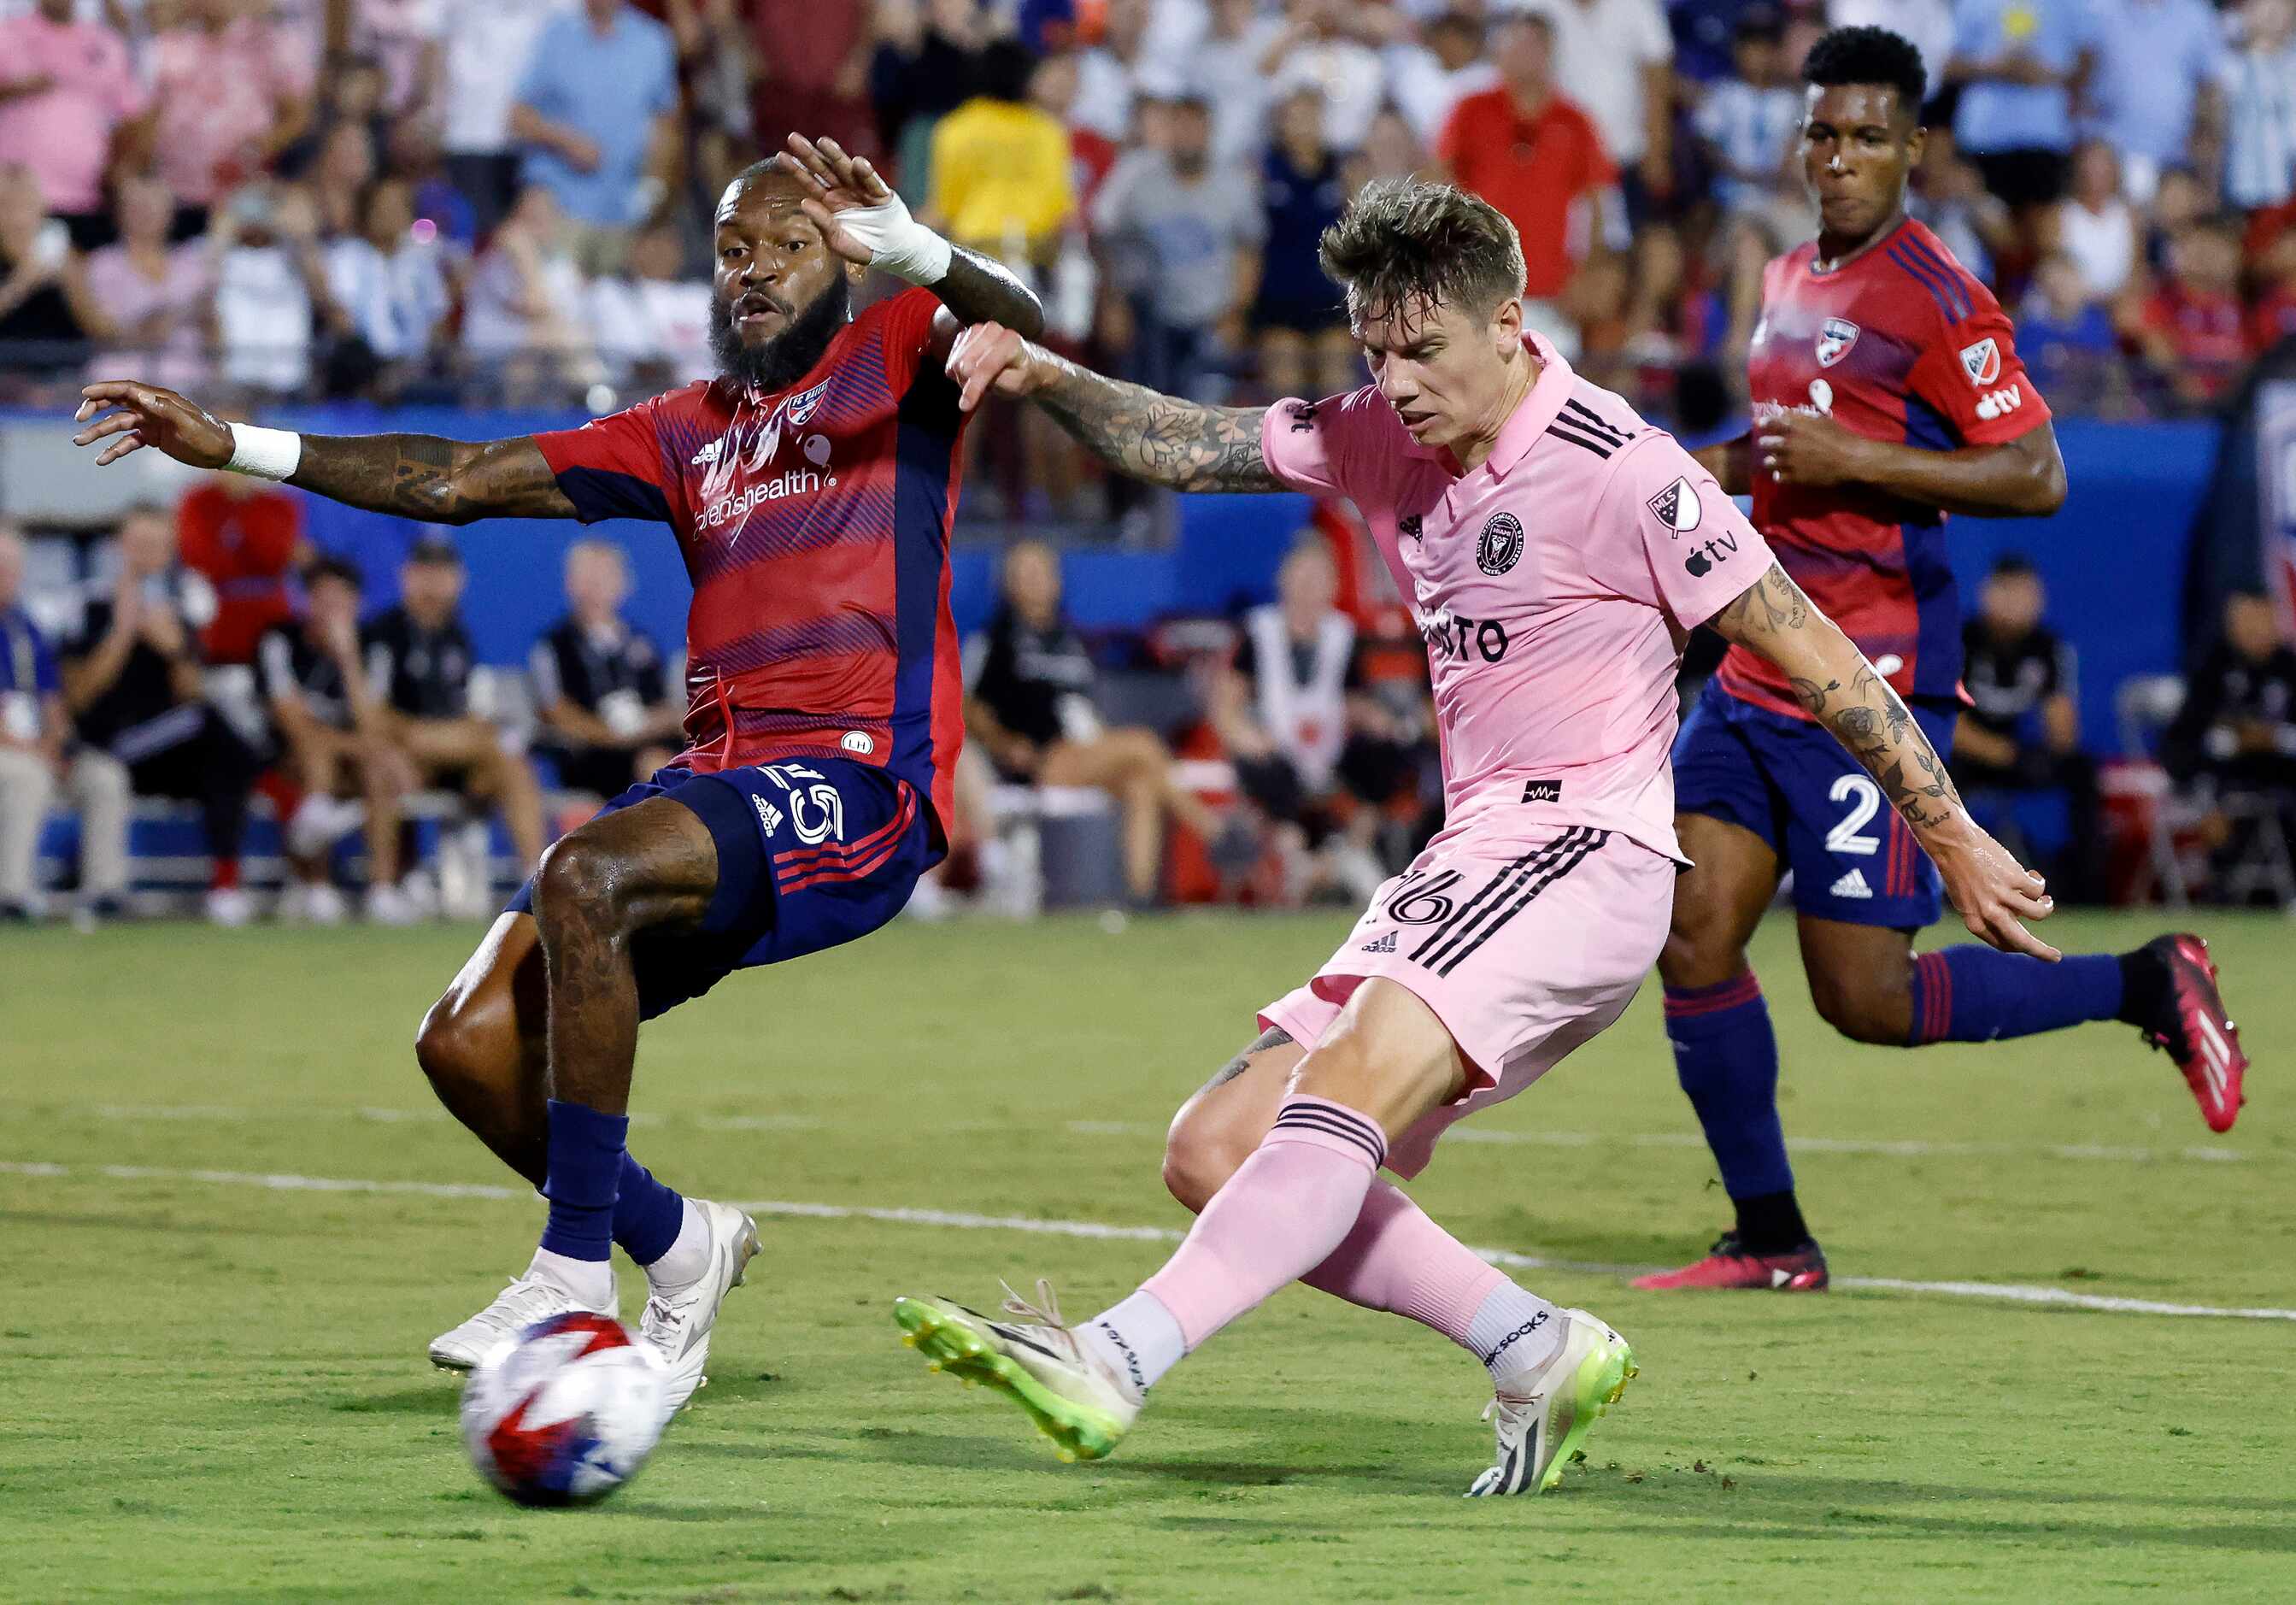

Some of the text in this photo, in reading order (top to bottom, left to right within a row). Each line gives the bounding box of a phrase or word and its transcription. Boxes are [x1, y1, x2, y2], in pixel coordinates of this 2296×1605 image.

[1653, 491, 1676, 511] MLS
[1705, 530, 1738, 561] tv
[849, 738, 866, 750] LH
[752, 793, 774, 838] adidas
[1825, 773, 1881, 855] 2
